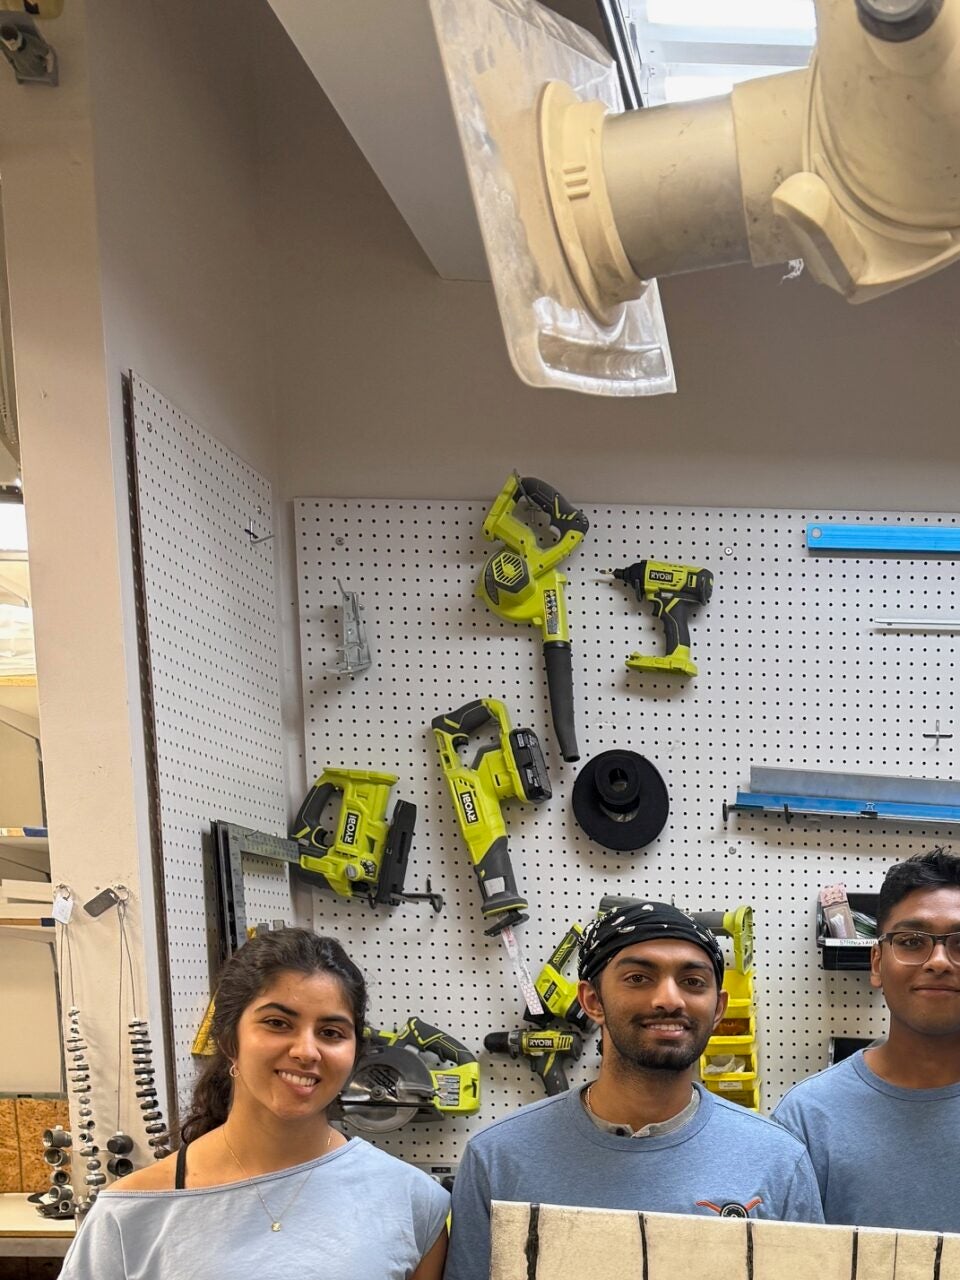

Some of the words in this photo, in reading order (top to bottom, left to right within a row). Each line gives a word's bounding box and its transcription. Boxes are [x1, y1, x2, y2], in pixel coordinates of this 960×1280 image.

[650, 571, 673, 581] RYOBI
[461, 793, 478, 824] RYOBI
[344, 815, 359, 844] RYOBI
[529, 1039, 553, 1047] RYOBI
